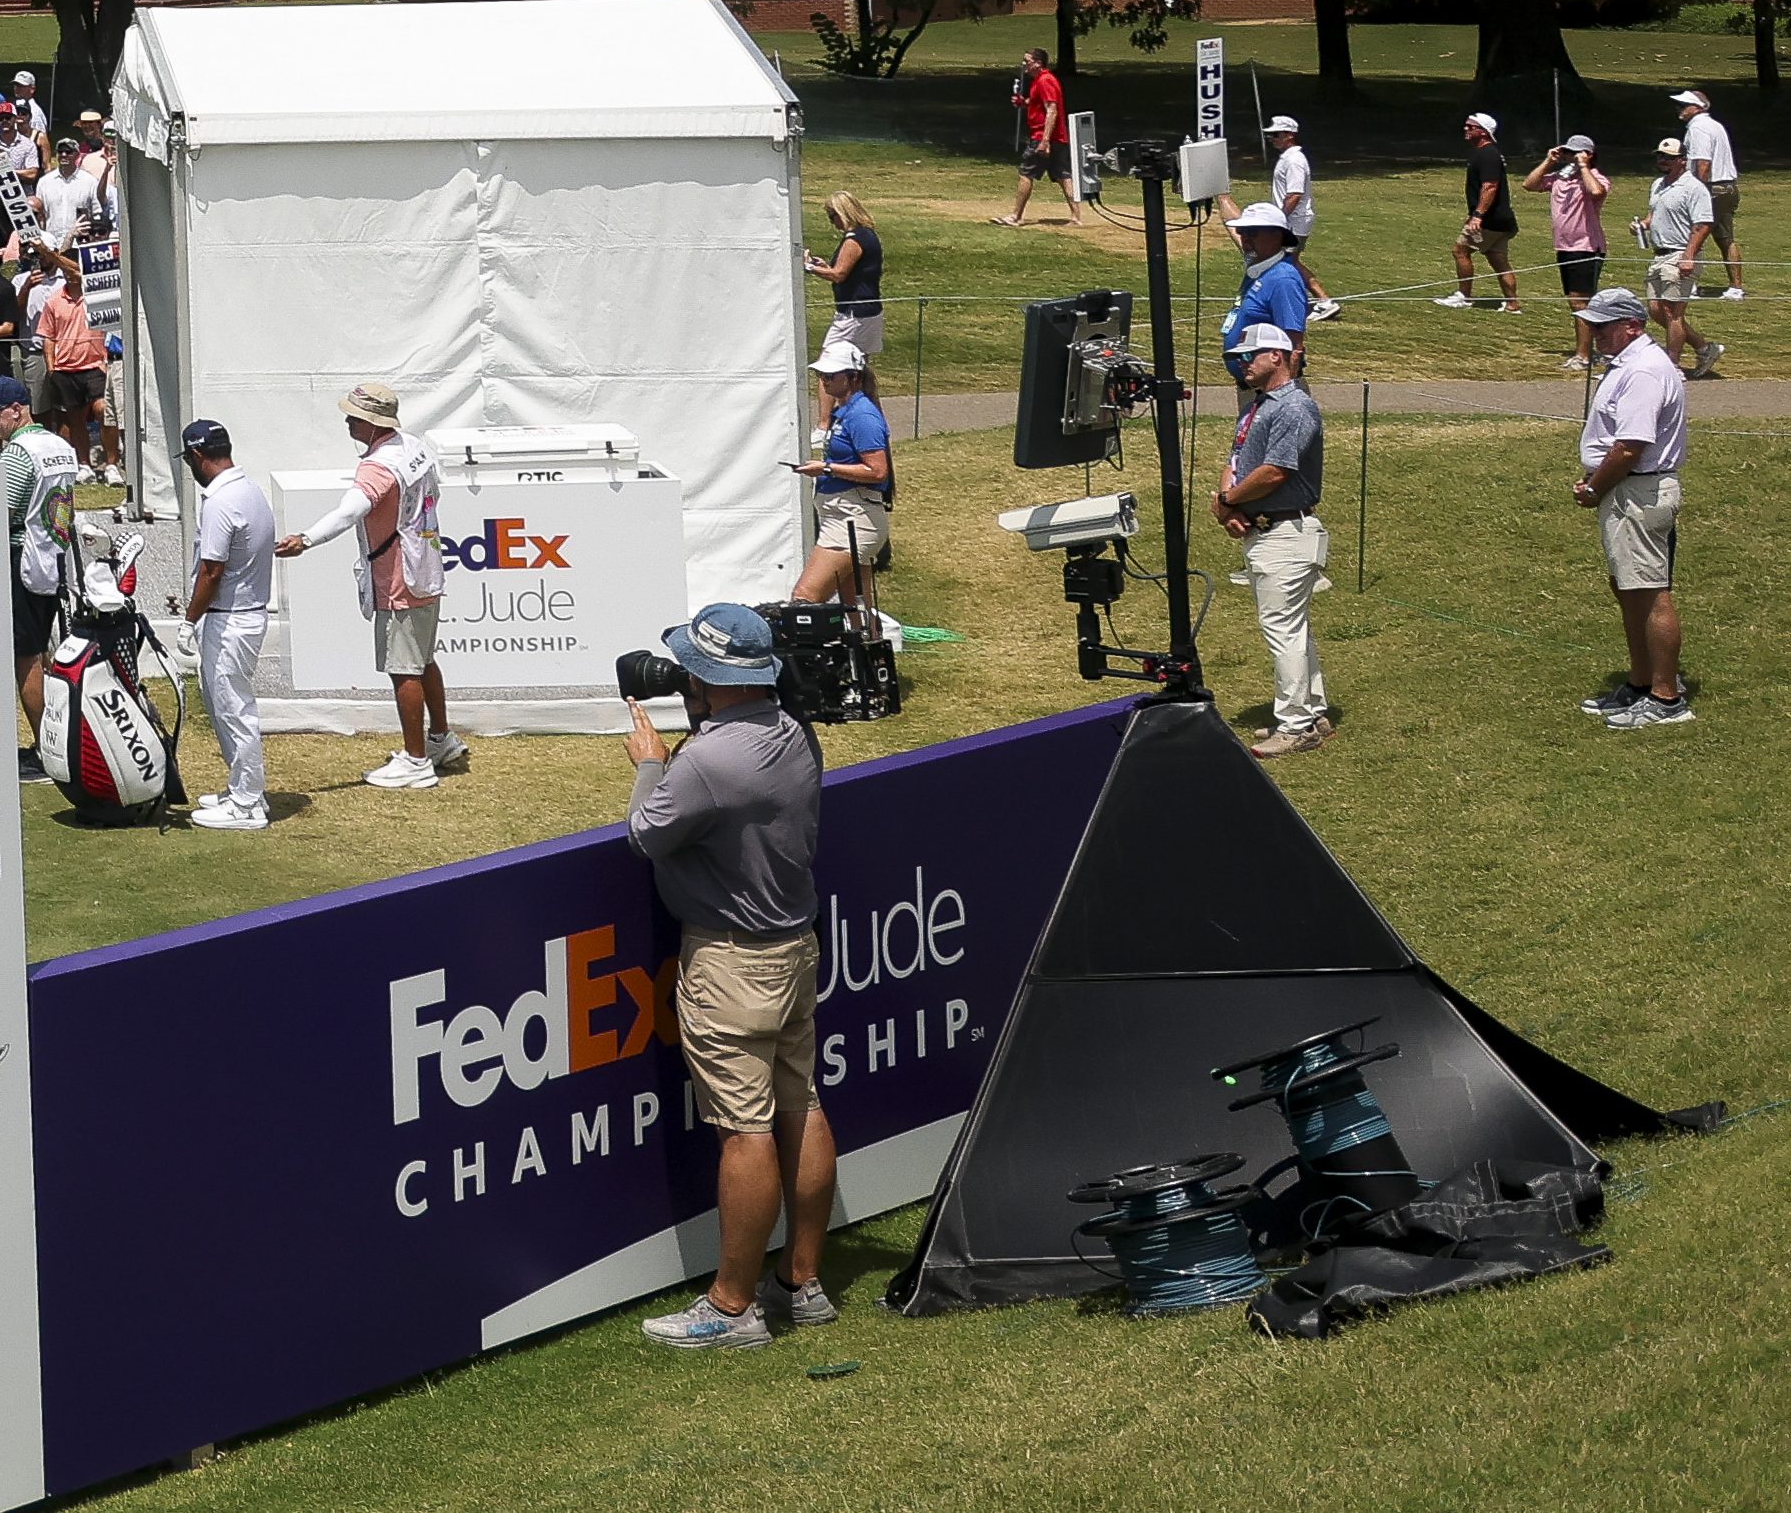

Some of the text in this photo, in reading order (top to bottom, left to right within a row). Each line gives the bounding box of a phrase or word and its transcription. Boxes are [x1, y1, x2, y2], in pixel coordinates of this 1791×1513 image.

[1200, 63, 1222, 139] HUSH
[88, 243, 120, 263] FedE
[439, 518, 573, 572] edEx
[464, 578, 575, 623] Jude
[434, 636, 577, 653] AMPIONSHIP
[97, 689, 159, 783] SRIXON
[389, 923, 681, 1126] FedEx
[395, 998, 969, 1218] CHAMPISHIP
